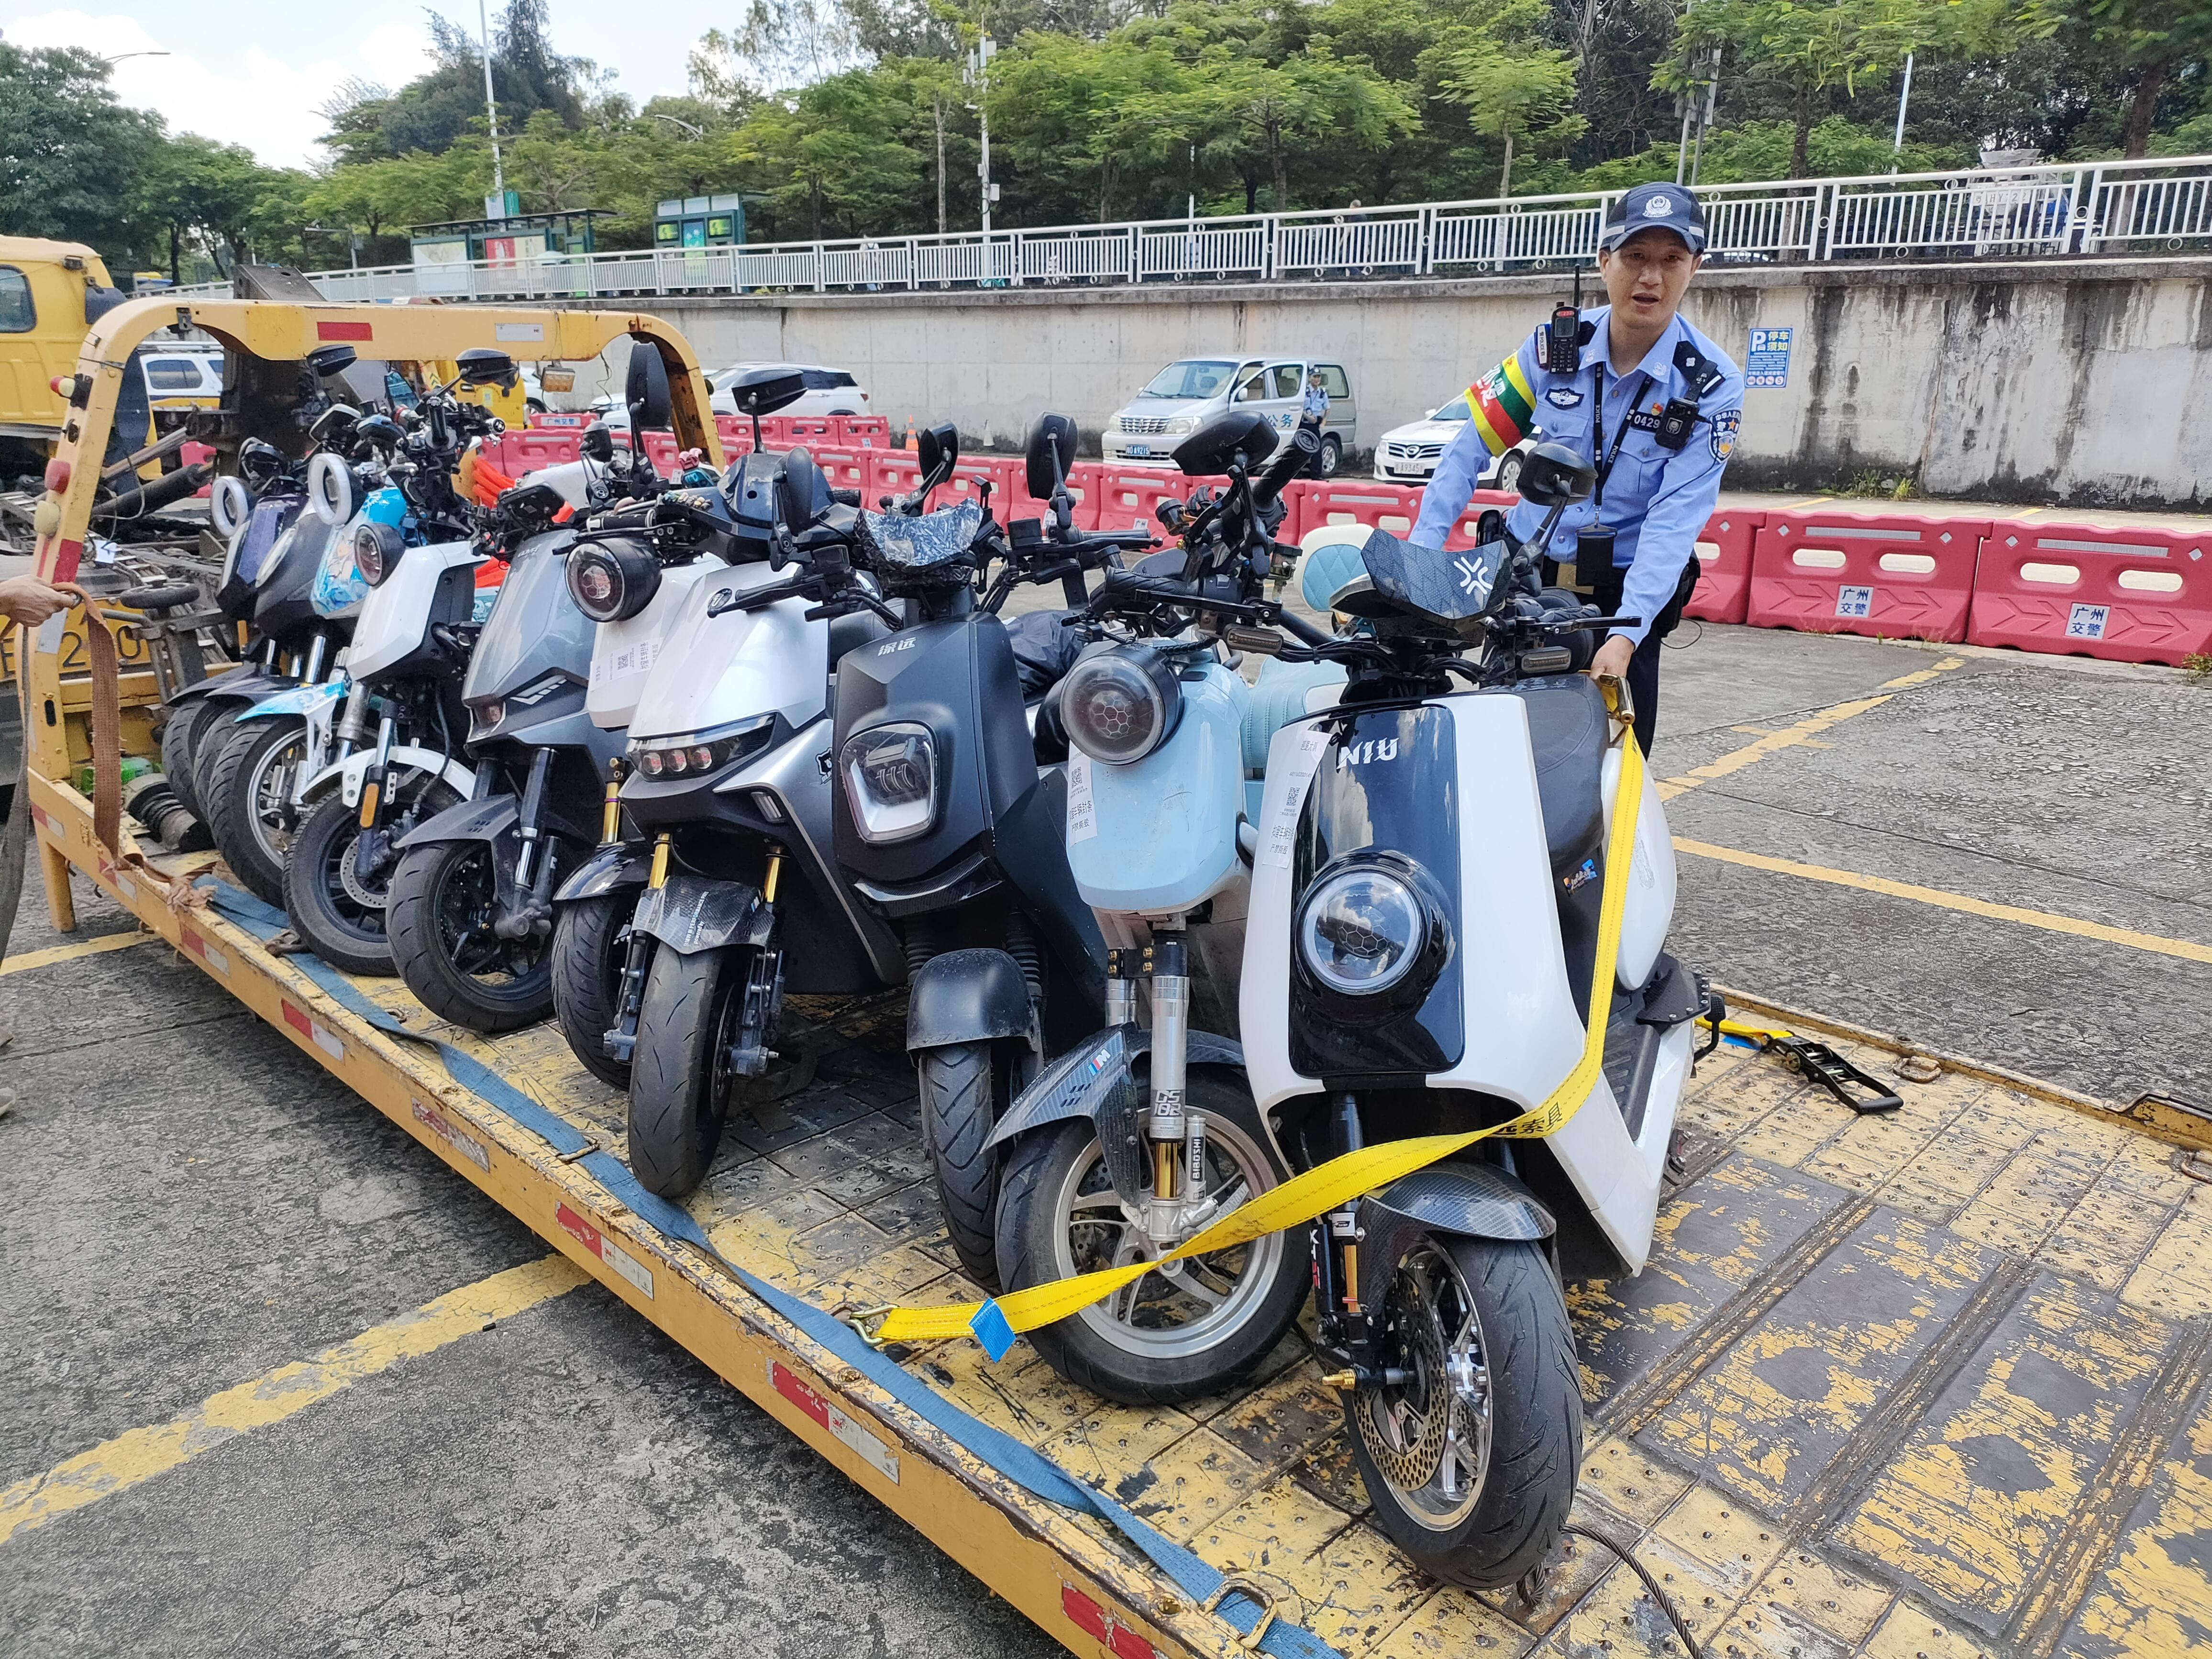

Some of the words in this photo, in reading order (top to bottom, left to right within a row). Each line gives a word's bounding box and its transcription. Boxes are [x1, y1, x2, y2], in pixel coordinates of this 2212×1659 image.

[1751, 332, 1766, 352] P
[1768, 331, 1789, 341] 停车
[1767, 342, 1788, 351] 须知
[1267, 414, 1294, 428] 公务
[1634, 414, 1660, 429] 0429
[1608, 444, 1618, 464] POLICE
[1842, 588, 1869, 601] 广州
[1840, 603, 1867, 615] 交警
[2073, 607, 2105, 621] 广州
[2070, 622, 2101, 636] 交警
[1336, 737, 1399, 769] NIU
[689, 899, 705, 929] PERFORMANCE
[1155, 1091, 1181, 1103] GS
[1153, 1103, 1184, 1117] 102
[1193, 1139, 1201, 1180] BIBOSHI
